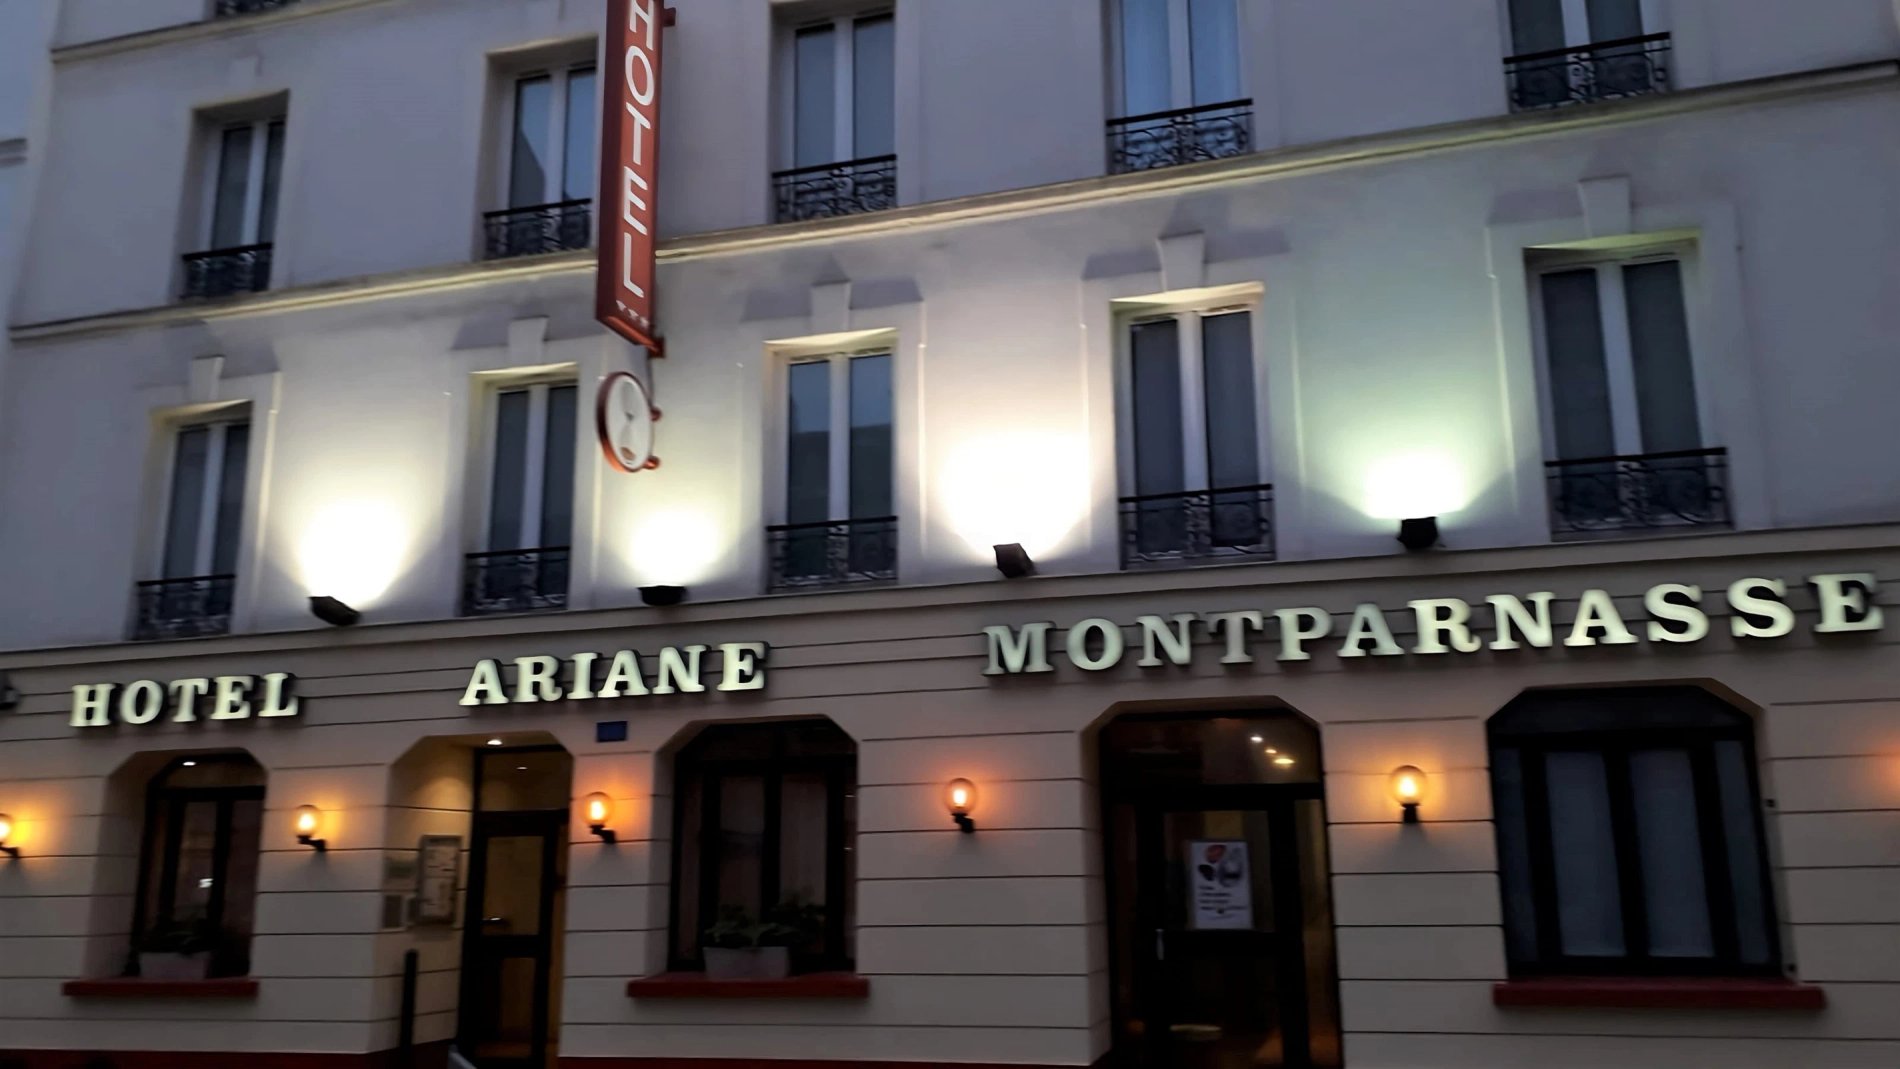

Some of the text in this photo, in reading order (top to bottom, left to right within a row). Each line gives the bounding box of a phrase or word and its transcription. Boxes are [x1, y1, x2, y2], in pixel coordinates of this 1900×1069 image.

[622, 0, 655, 299] HOTEL
[69, 572, 1884, 728] HOTEL ARIANE MONTPARNASSE
